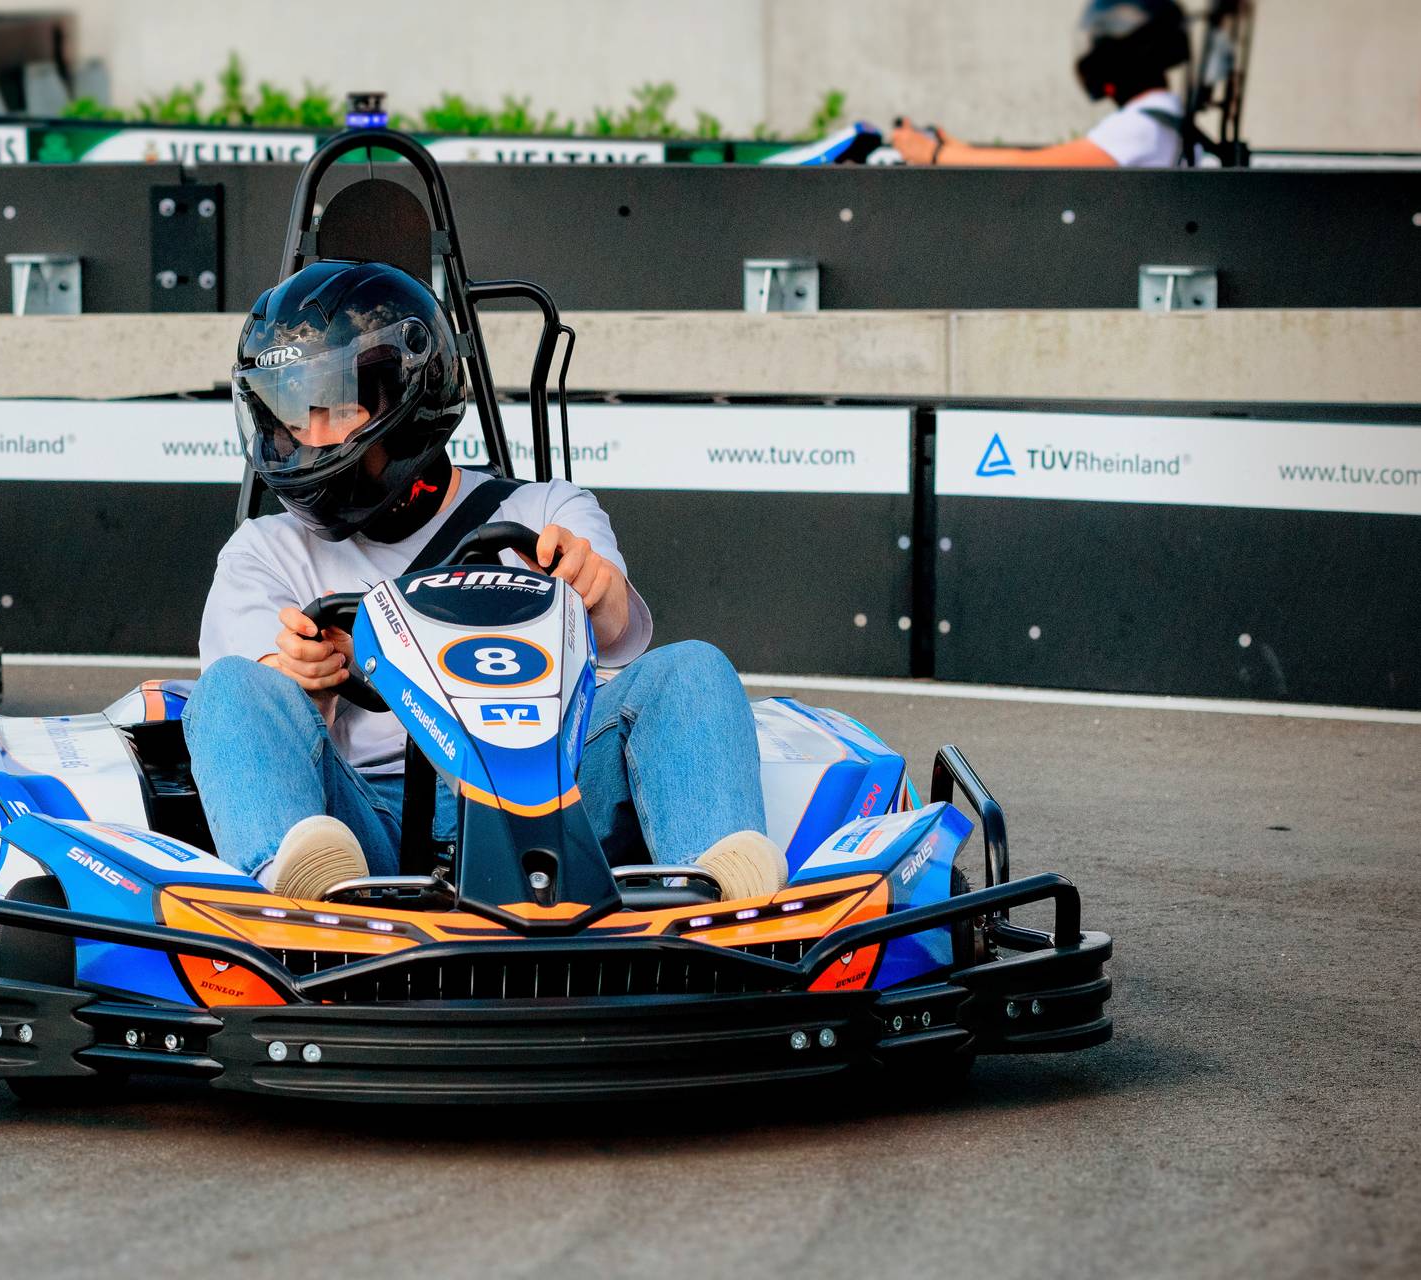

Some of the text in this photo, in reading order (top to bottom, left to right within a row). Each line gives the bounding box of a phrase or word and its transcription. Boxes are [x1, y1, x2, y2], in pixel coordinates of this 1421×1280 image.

[707, 446, 856, 465] www.tuv.com
[460, 584, 547, 596] GERMANY
[474, 647, 521, 676] 8
[401, 688, 456, 761] vb-sauerland.de
[200, 981, 244, 997] DUNLOP
